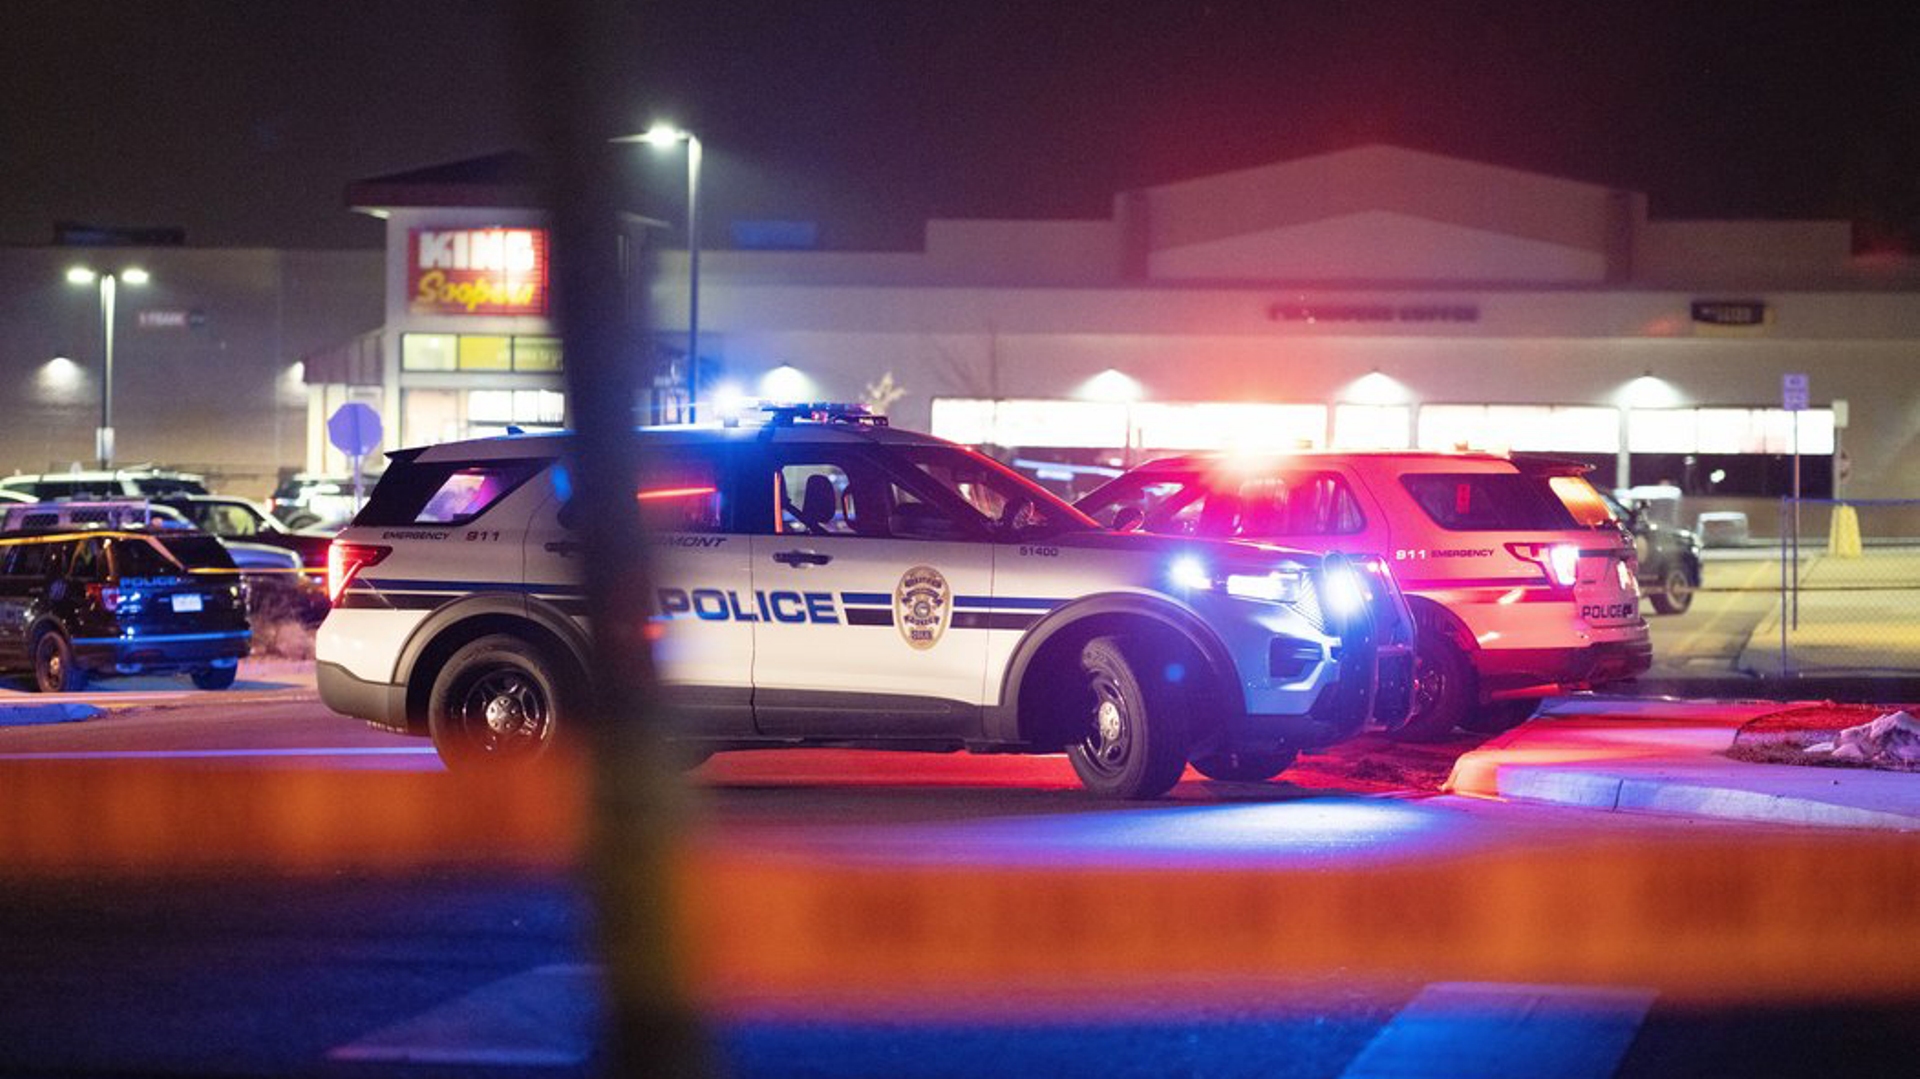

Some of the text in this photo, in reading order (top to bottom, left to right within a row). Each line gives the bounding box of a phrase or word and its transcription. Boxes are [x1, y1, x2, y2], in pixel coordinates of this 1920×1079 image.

[382, 531, 500, 541] EMERGENCY 911
[1396, 549, 1494, 560] 911 EMERGENCY
[120, 577, 176, 587] POLICE
[656, 588, 839, 624] POLICE
[1582, 604, 1622, 618] POLICE
